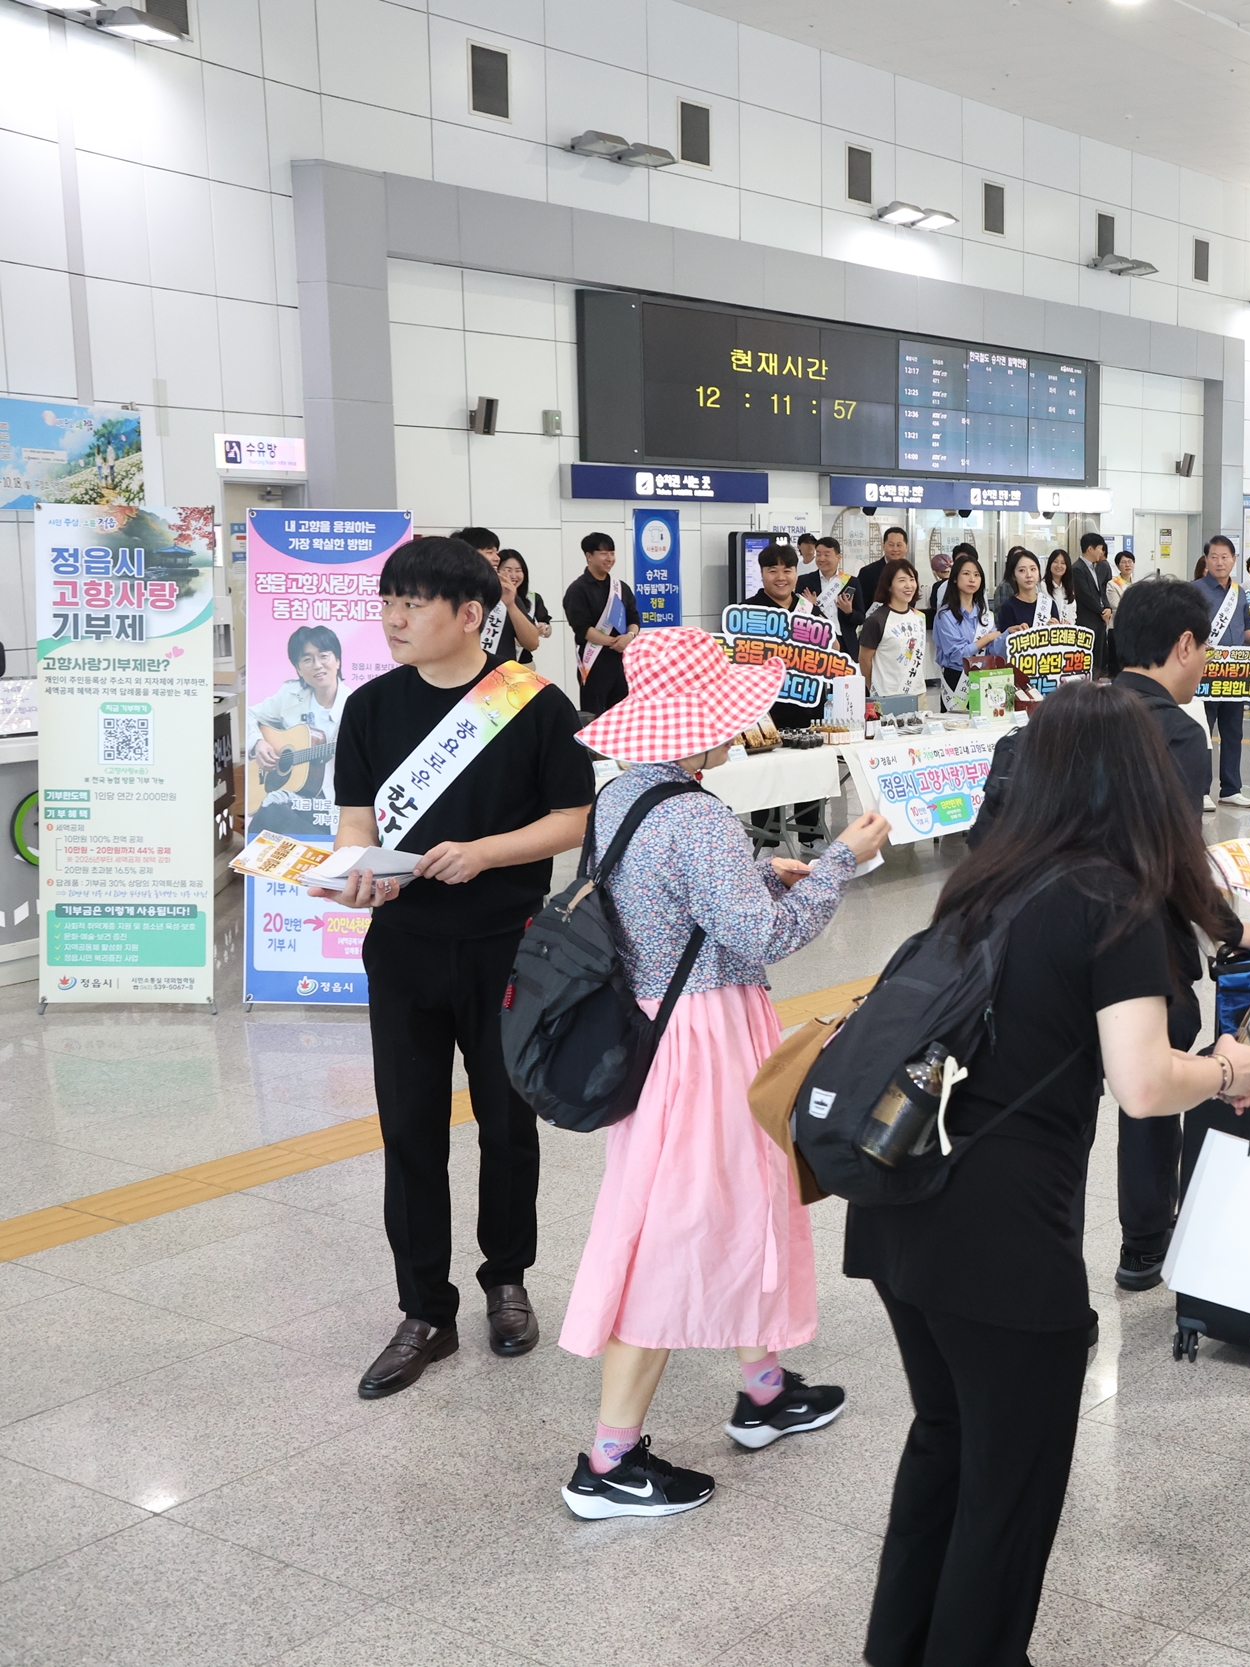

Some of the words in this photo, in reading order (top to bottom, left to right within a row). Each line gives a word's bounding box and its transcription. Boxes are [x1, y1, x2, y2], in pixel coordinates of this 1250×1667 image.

[730, 349, 828, 380] 현재시간
[904, 366, 920, 375] 12:17
[904, 388, 919, 396] 12:25
[696, 386, 720, 408] 12
[770, 393, 790, 415] 11
[833, 400, 857, 420] 57
[904, 410, 919, 418] 12:36
[904, 432, 918, 440] 13:21
[246, 442, 277, 458] 수유방
[904, 453, 918, 461] 14:00
[655, 474, 680, 488] 승차권
[879, 485, 896, 496] 승차권
[285, 520, 296, 532] 내
[298, 520, 330, 534] 고향을
[334, 520, 376, 534] 응원하는
[788, 526, 806, 534] TRAIN
[288, 538, 310, 550] 가장
[312, 538, 344, 550] 확실한
[347, 538, 372, 551] 방법!
[51, 548, 145, 576] 정읍시
[646, 569, 668, 581] 승차권
[256, 572, 286, 594] 정읍
[636, 584, 679, 594] 자동발매기가
[52, 580, 179, 610] 고향사랑
[650, 598, 665, 608] 정말
[272, 598, 309, 620] 동참
[314, 598, 383, 621] 해주세요
[642, 612, 674, 623] 편리합니다
[52, 613, 145, 641] 기부제
[728, 608, 790, 639] 아들아,
[792, 617, 830, 647] 딸아
[1210, 613, 1229, 637] 한가위
[1010, 630, 1048, 654] 기부하고
[1050, 628, 1076, 644] 답례품
[1077, 630, 1092, 648] 받고
[43, 657, 170, 672] 고향사랑기부제란?
[352, 662, 372, 671] 정읍시
[908, 649, 924, 678] 한가위
[1038, 654, 1062, 674] 살던
[1063, 652, 1091, 671] 고향은
[44, 676, 67, 684] 개인이
[69, 676, 107, 685] 주민등록상
[110, 677, 132, 686] 주소지
[144, 678, 174, 686] 지자체에
[176, 678, 208, 687] 기부하면,
[352, 674, 365, 682] 가수
[44, 687, 74, 695] 세액공제
[76, 687, 100, 696] 혜택과
[102, 688, 117, 696] 지역
[120, 688, 150, 696] 답례품을
[152, 688, 182, 697] 제공받는
[184, 689, 198, 697] 제도
[106, 704, 120, 712] 지금
[122, 704, 148, 712] 기부하기
[411, 719, 478, 790] 풍요로운
[880, 756, 898, 766] 정읍시
[880, 774, 918, 800] 정읍시
[916, 761, 991, 792] 고향사랑기부제
[46, 791, 88, 800] 기부한도액
[94, 792, 115, 801] 1인당
[117, 792, 134, 801] 연간
[136, 792, 177, 802] 2,000만원
[292, 798, 312, 811] 지금
[314, 798, 332, 811] 바로
[56, 824, 85, 832] 세액공제
[64, 836, 88, 844] 10만원
[90, 836, 110, 844] 100%
[112, 836, 127, 844] 전액
[130, 836, 144, 844] 공제
[64, 846, 88, 854] 10만원
[96, 846, 135, 854] 20만원까지
[137, 846, 154, 854] 44%
[157, 846, 171, 854] 공제
[64, 866, 88, 875] 20만원
[92, 866, 112, 874] 초과분
[114, 866, 137, 874] 16.5%
[139, 866, 154, 874] 공제
[56, 880, 79, 888] 답례품
[85, 880, 107, 888] 기부금
[109, 880, 126, 888] 30%
[152, 880, 187, 888] 지역특산품
[189, 880, 204, 888] 제공
[266, 882, 287, 896] 기부
[289, 883, 299, 896] 시
[62, 906, 102, 916] 기부금은
[104, 906, 134, 916] 이렇게
[137, 906, 190, 916] 사용됩니다!
[64, 922, 86, 930] 사회적
[263, 912, 302, 933] 20만원
[64, 944, 100, 952] 지역공동체
[124, 944, 138, 952] 지원
[267, 938, 286, 952] 기부
[288, 939, 296, 952] 시
[64, 954, 92, 962] 정읍시민
[124, 954, 138, 962] 사업
[80, 978, 112, 988] 정읍시
[320, 981, 354, 992] 정읍시
